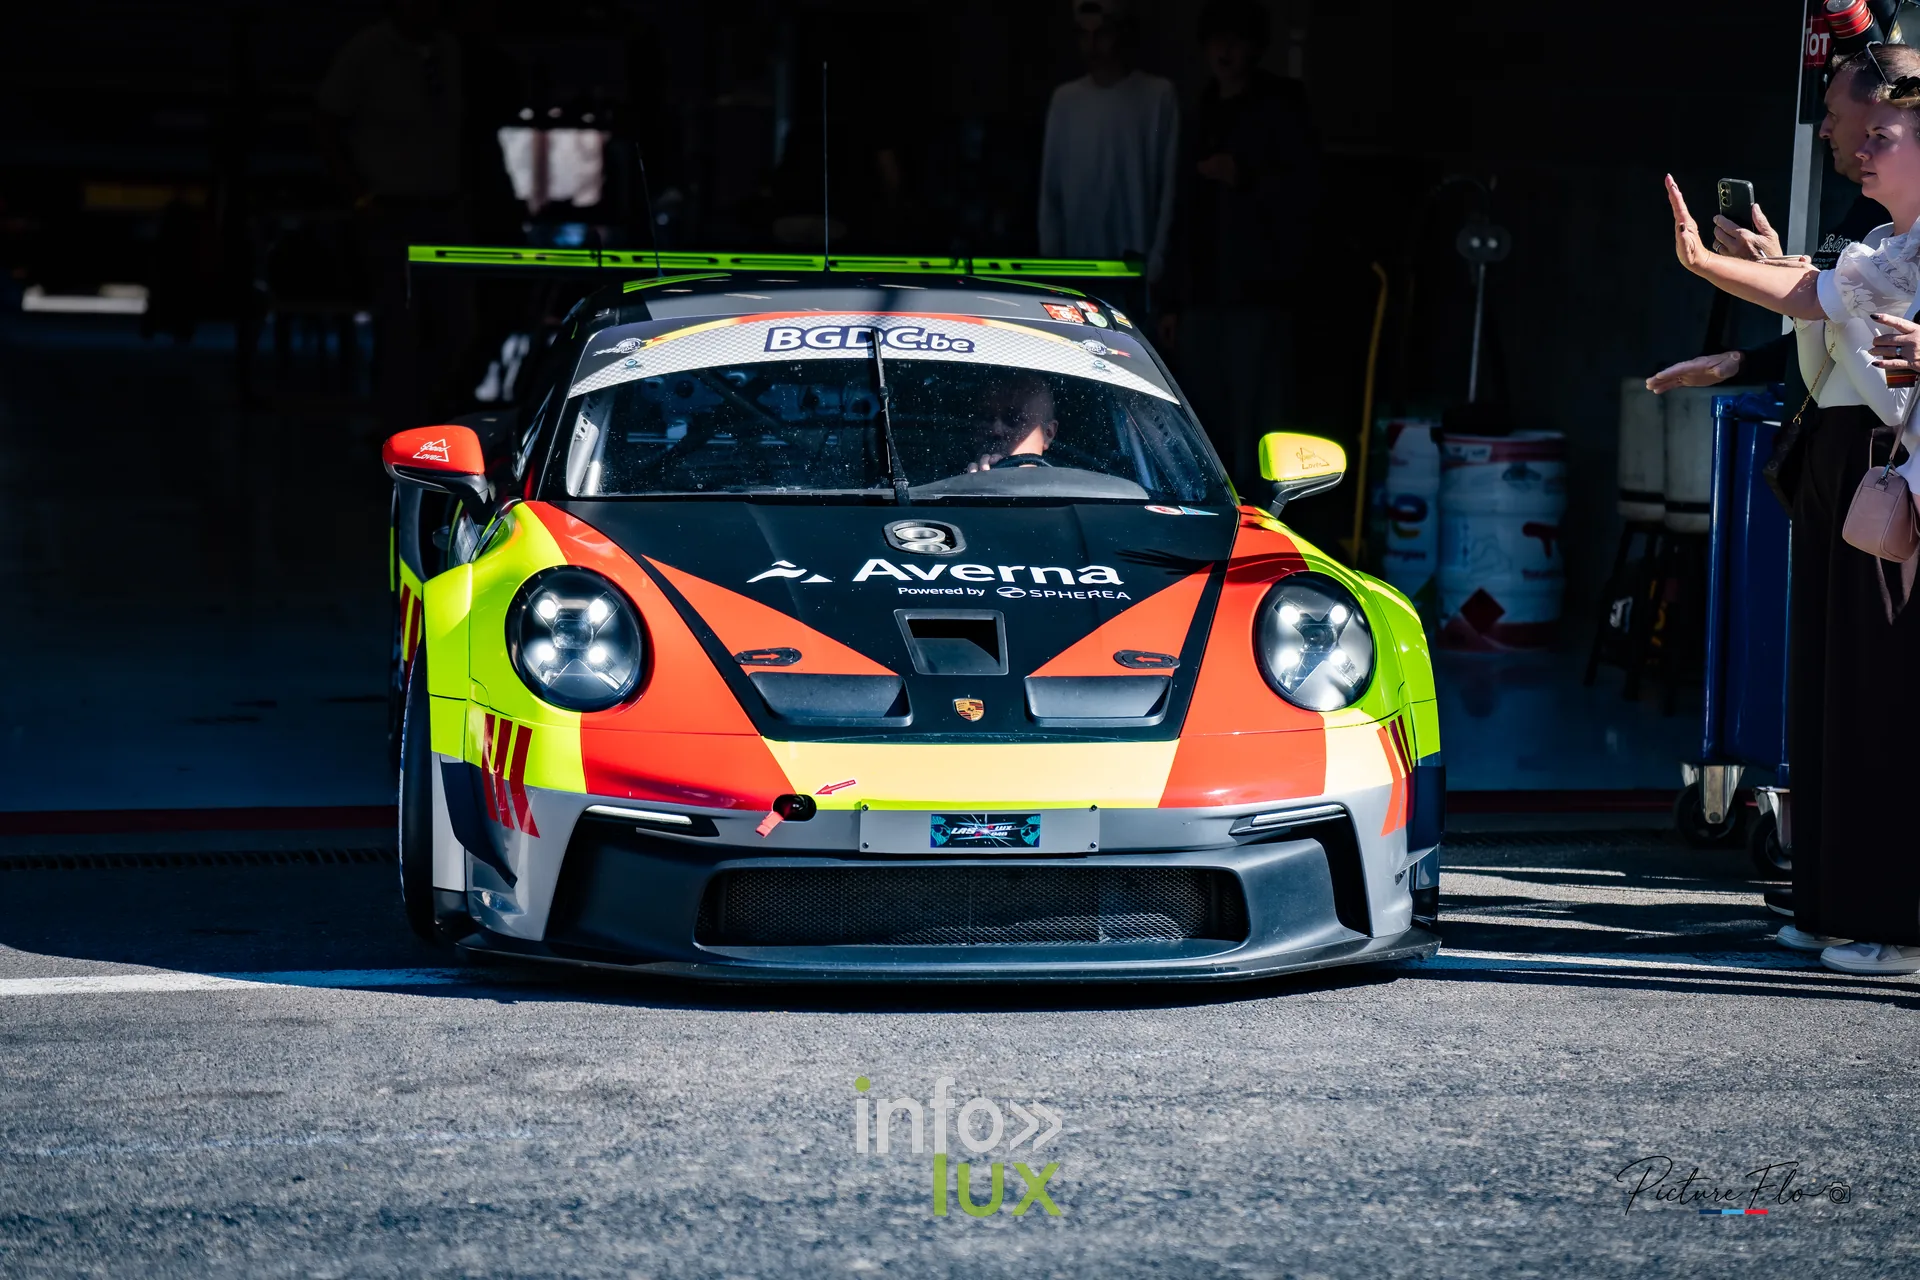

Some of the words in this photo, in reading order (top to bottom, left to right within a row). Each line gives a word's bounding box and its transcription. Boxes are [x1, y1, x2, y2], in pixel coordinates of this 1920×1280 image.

[766, 326, 973, 352] BGDC.be
[852, 558, 1124, 585] Averna
[897, 582, 964, 595] Powered
[966, 582, 986, 597] by
[1029, 589, 1132, 600] SPHEREA
